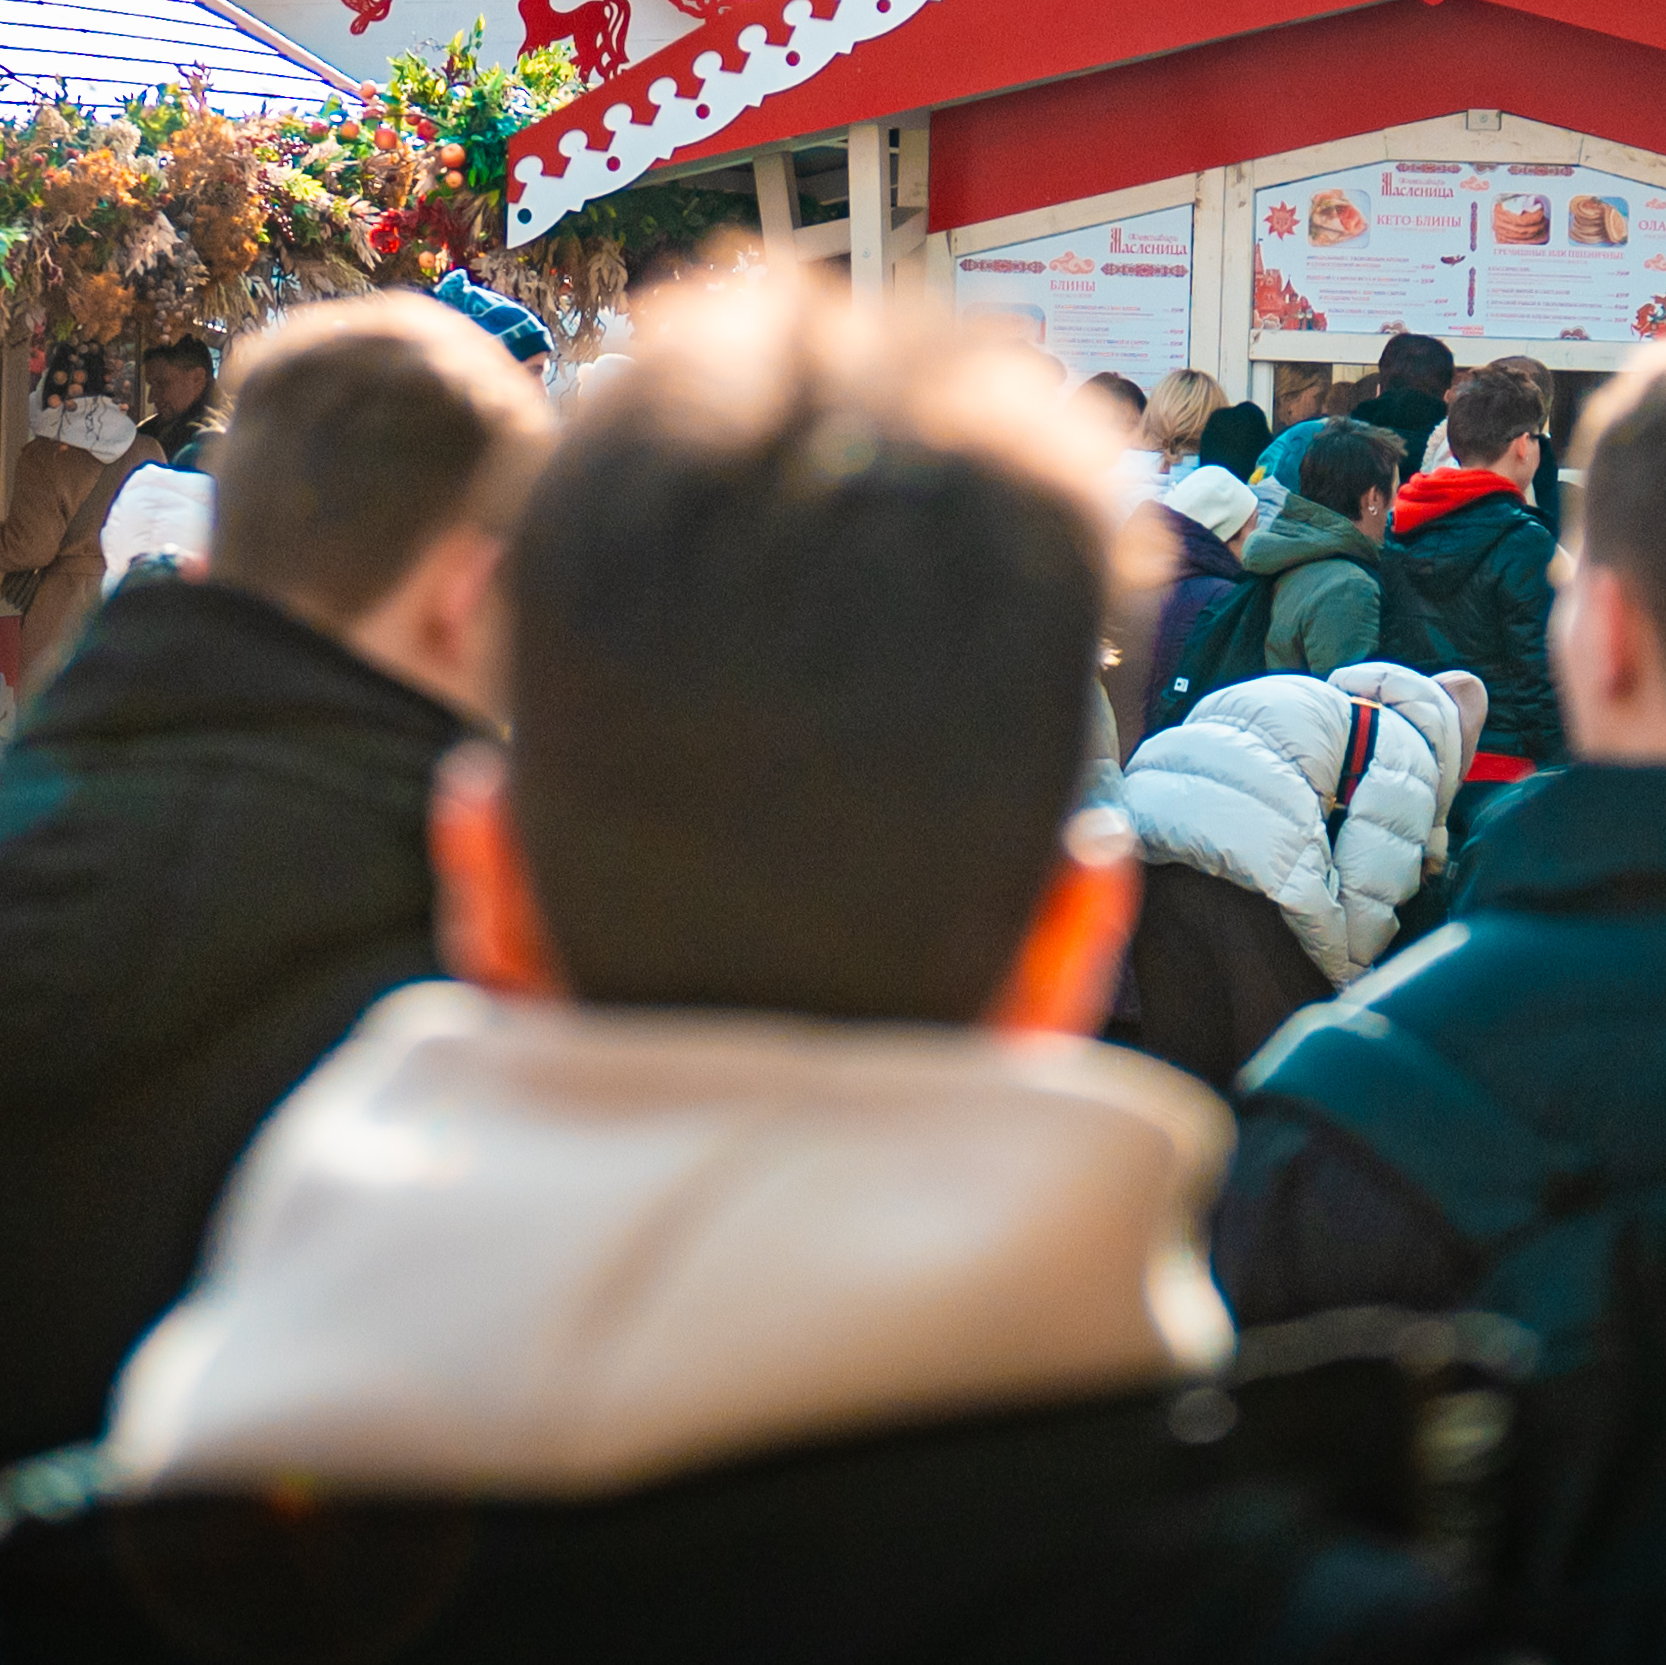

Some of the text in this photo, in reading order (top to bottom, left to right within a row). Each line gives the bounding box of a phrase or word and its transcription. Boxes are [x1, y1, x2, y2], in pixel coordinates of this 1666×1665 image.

[1381, 171, 1455, 199] Масленица
[1377, 214, 1462, 228] КЕТО-БЛИНЫ
[1110, 227, 1187, 256] Масленица
[1050, 279, 1096, 292] БЛИНЫ
